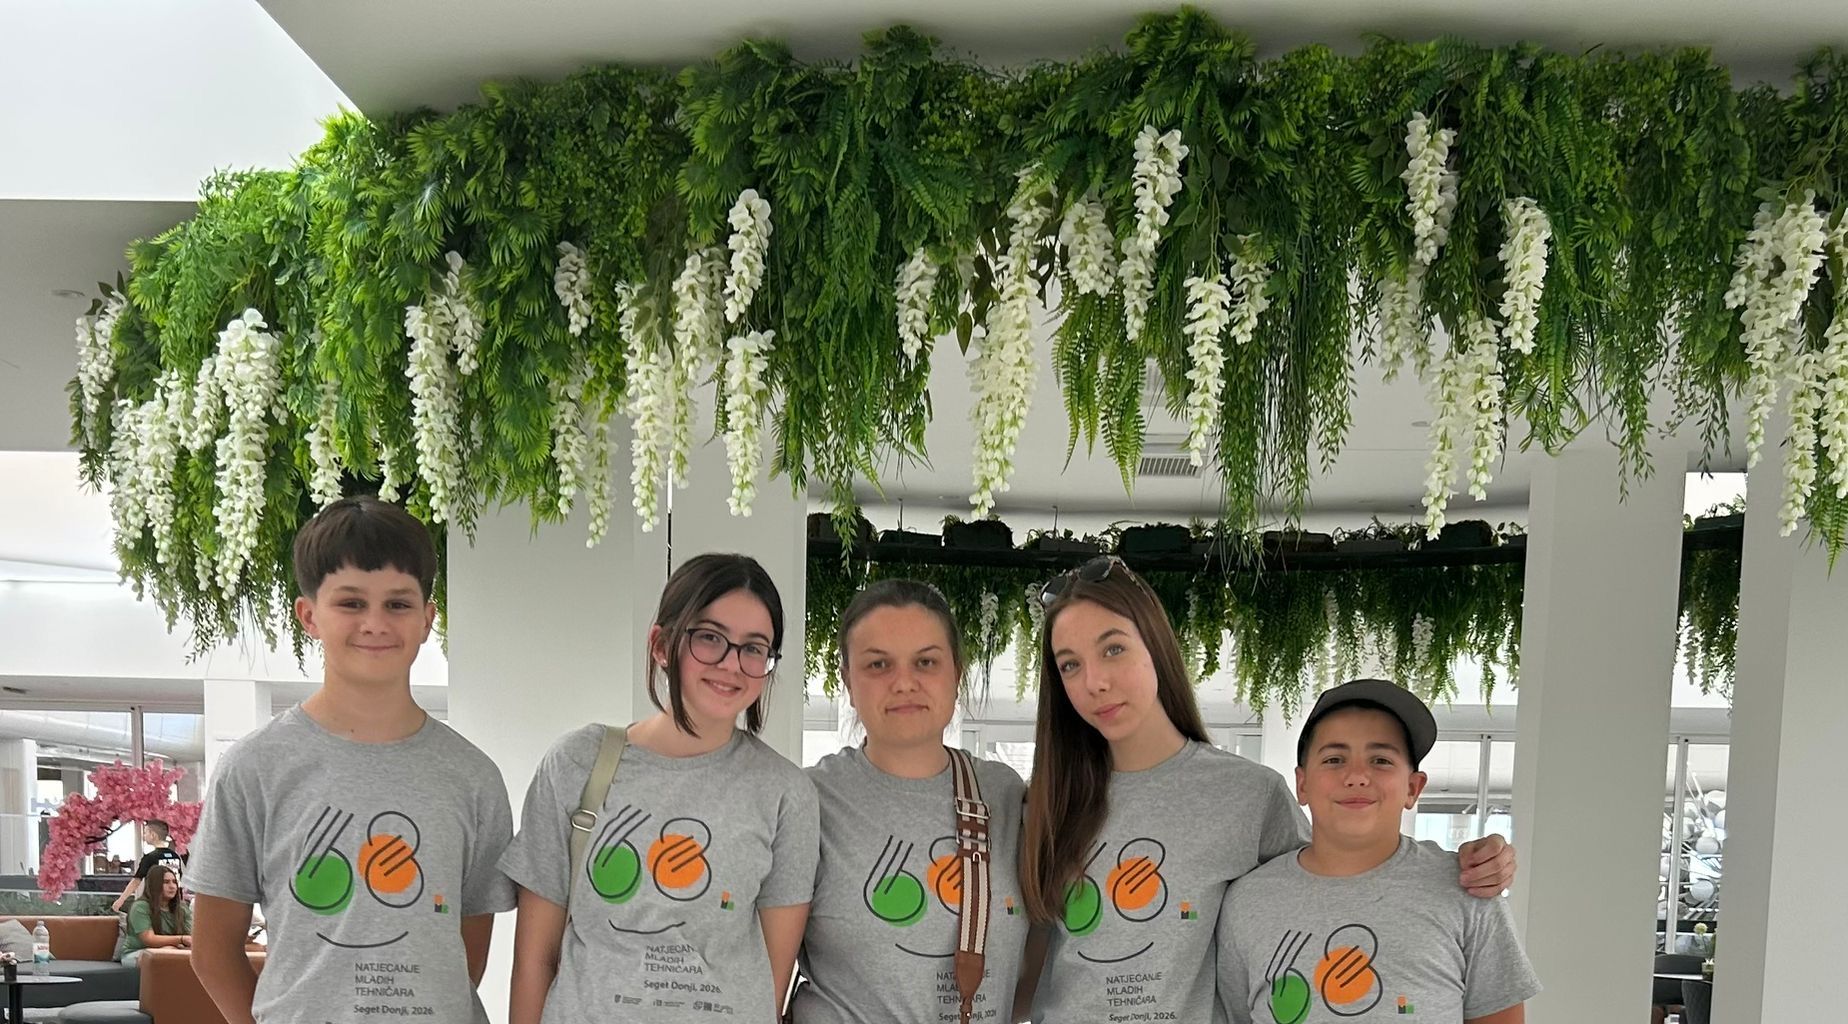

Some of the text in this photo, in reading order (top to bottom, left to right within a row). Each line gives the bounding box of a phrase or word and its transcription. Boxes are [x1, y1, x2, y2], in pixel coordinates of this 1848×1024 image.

[354, 962, 421, 974] NATJECANJE
[354, 974, 395, 985] MLADIH
[643, 979, 669, 991] Seget
[354, 986, 415, 998] TEHNIČARA
[1106, 985, 1144, 996] MLADIH
[353, 1004, 380, 1015] Seget
